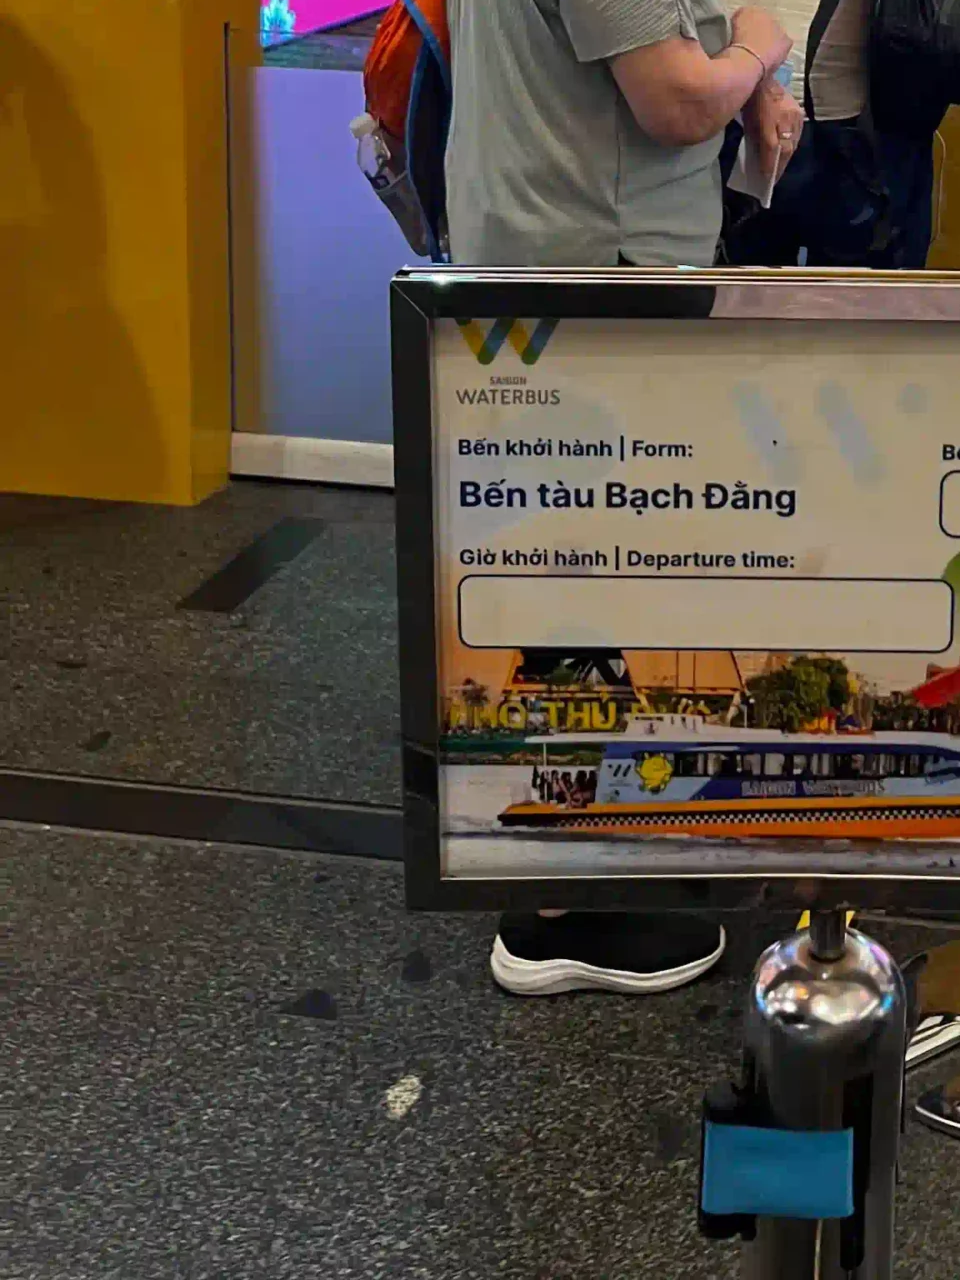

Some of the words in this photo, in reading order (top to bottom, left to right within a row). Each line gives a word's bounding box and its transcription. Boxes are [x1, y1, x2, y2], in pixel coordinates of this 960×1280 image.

[489, 375, 527, 386] SAIGON
[455, 388, 561, 406] WATERBUS
[457, 438, 500, 457] Bến
[505, 438, 553, 457] khởi
[558, 438, 613, 457] hành
[631, 440, 693, 458] Form:
[458, 478, 528, 508] Bến
[537, 480, 595, 509] tàu
[604, 481, 694, 516] Bạch
[701, 480, 797, 518] Đằng
[459, 548, 497, 566] Giờ
[502, 548, 548, 566] khởi
[554, 549, 608, 567] hành
[627, 550, 736, 571] Departure
[741, 552, 796, 569] time:
